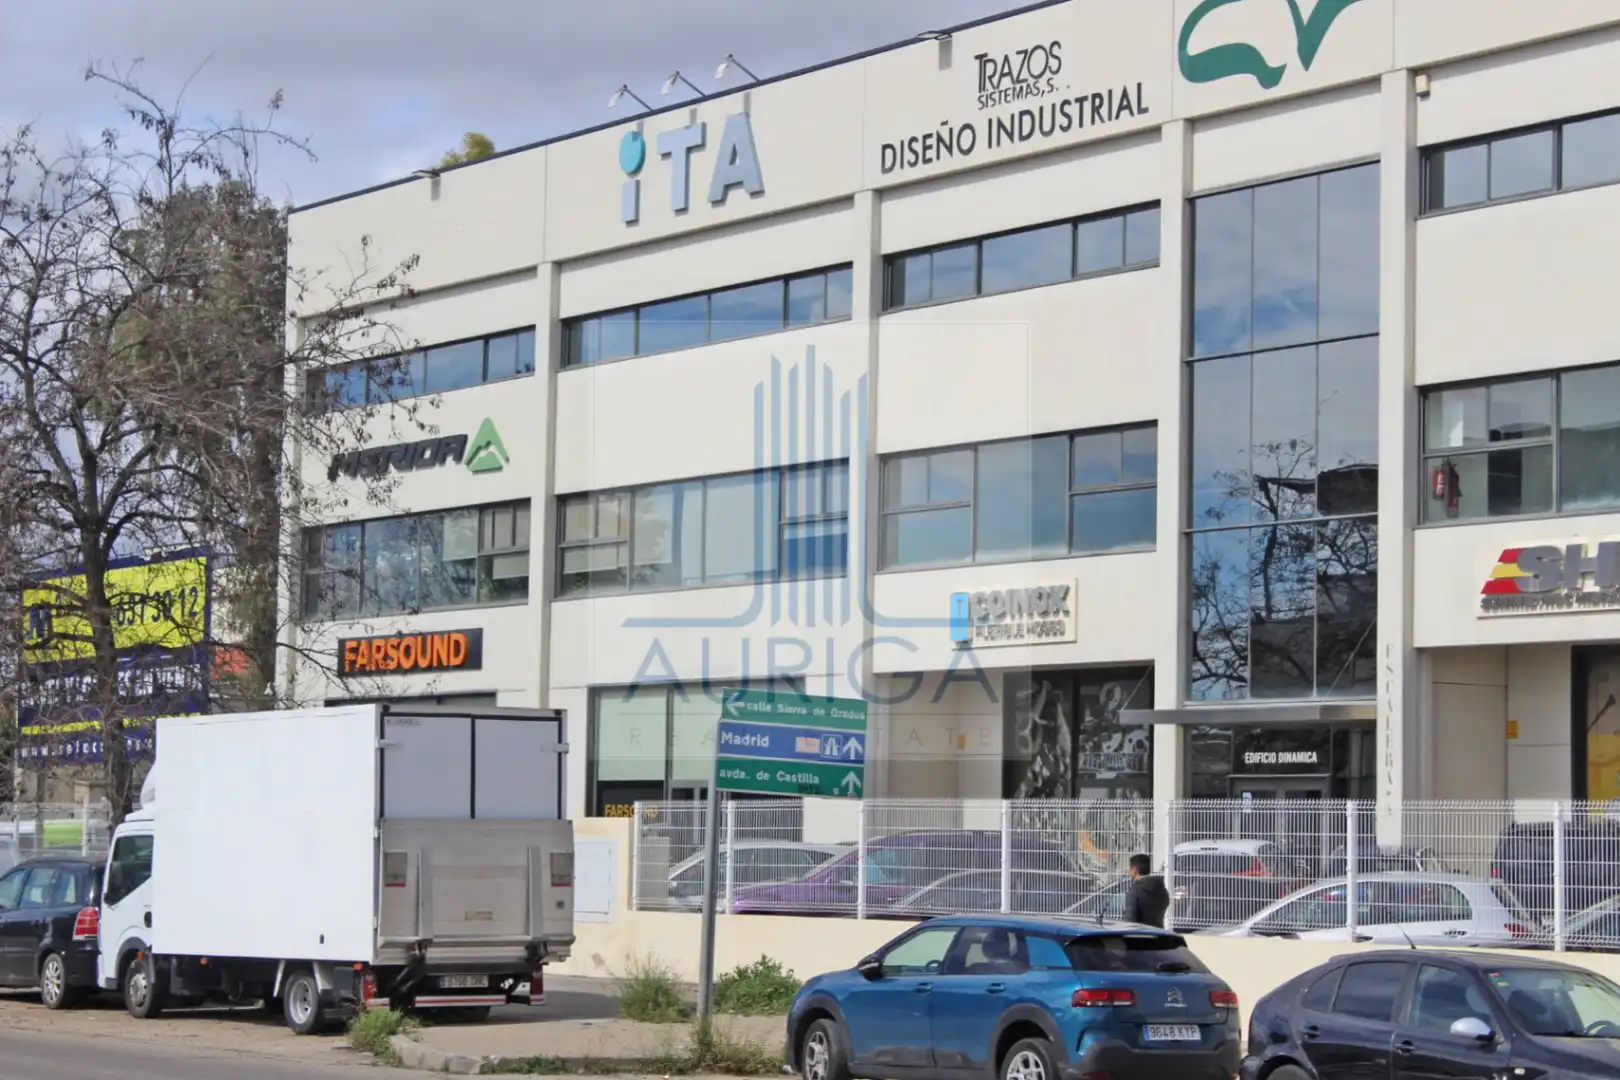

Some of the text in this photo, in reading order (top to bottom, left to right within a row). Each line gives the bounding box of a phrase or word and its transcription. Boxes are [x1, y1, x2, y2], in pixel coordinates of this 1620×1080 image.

[974, 40, 1062, 93] TRAZOS
[881, 82, 1150, 174] DISEÑO INDUSTRIAL
[344, 632, 468, 673] FARSOUND
[746, 701, 865, 720] calle Sierra de Gredos
[720, 731, 770, 748] Madrid
[1244, 751, 1318, 764] EDIFICIO DINAMICA
[719, 767, 820, 784] avda. de Castilla
